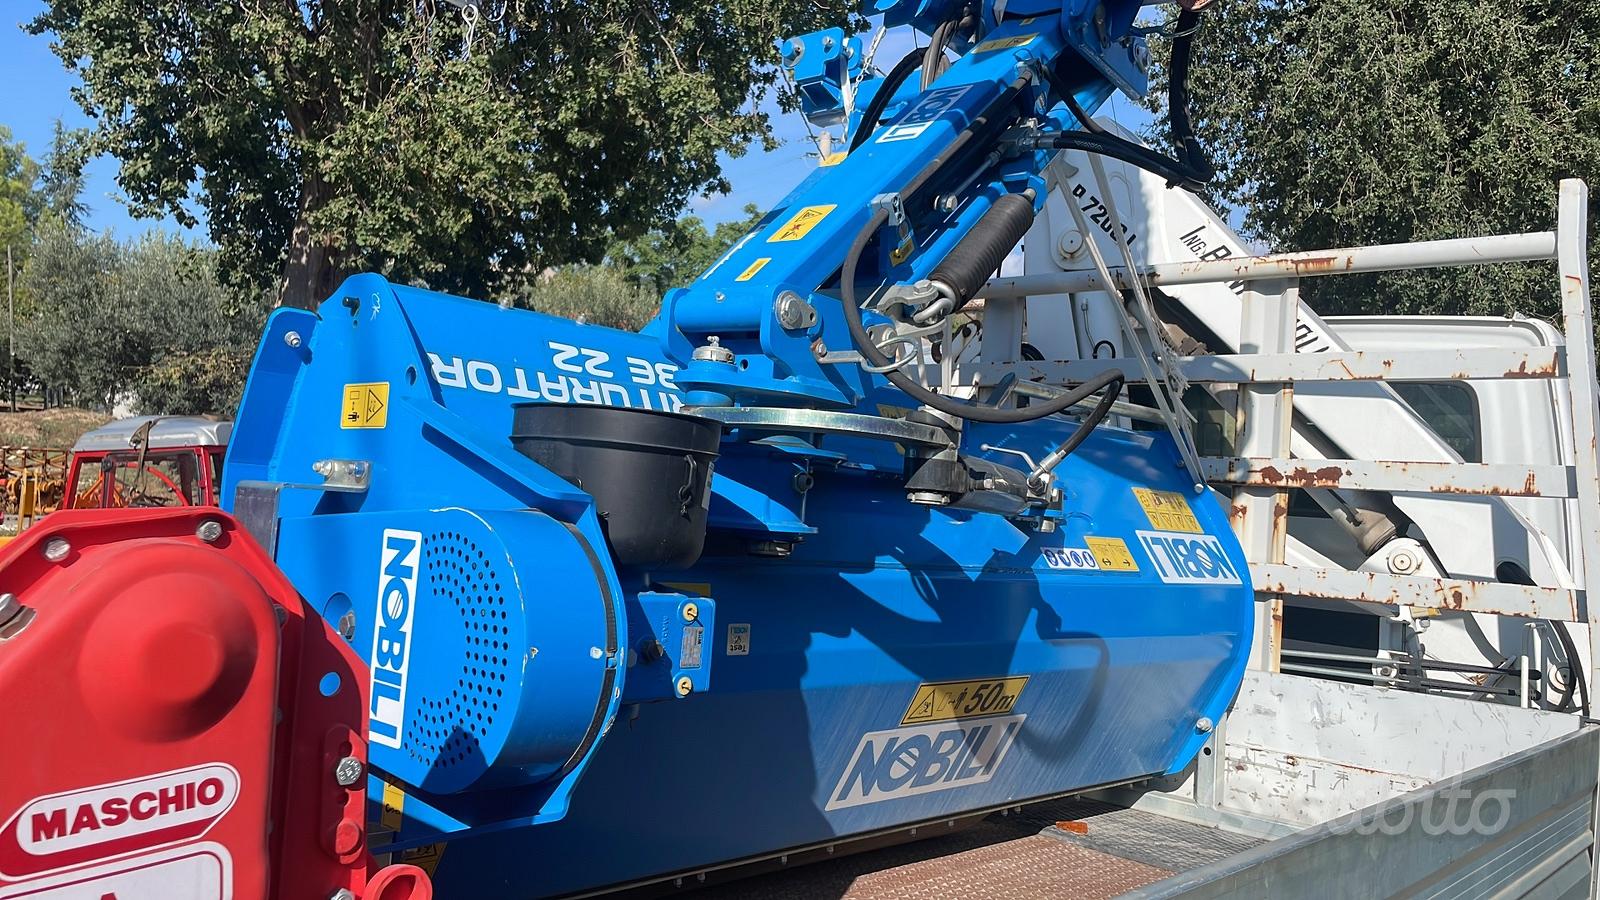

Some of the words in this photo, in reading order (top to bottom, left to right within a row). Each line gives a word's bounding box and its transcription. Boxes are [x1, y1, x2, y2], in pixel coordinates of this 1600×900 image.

[880, 88, 964, 141] NOBILI
[548, 340, 614, 378] 22
[1142, 535, 1238, 580] NOBILI
[370, 536, 417, 740] NOBILI
[729, 644, 747, 653] Test
[963, 682, 1016, 714] 50m
[835, 721, 1018, 802] NOBILI
[31, 777, 226, 844] MASCHIO
